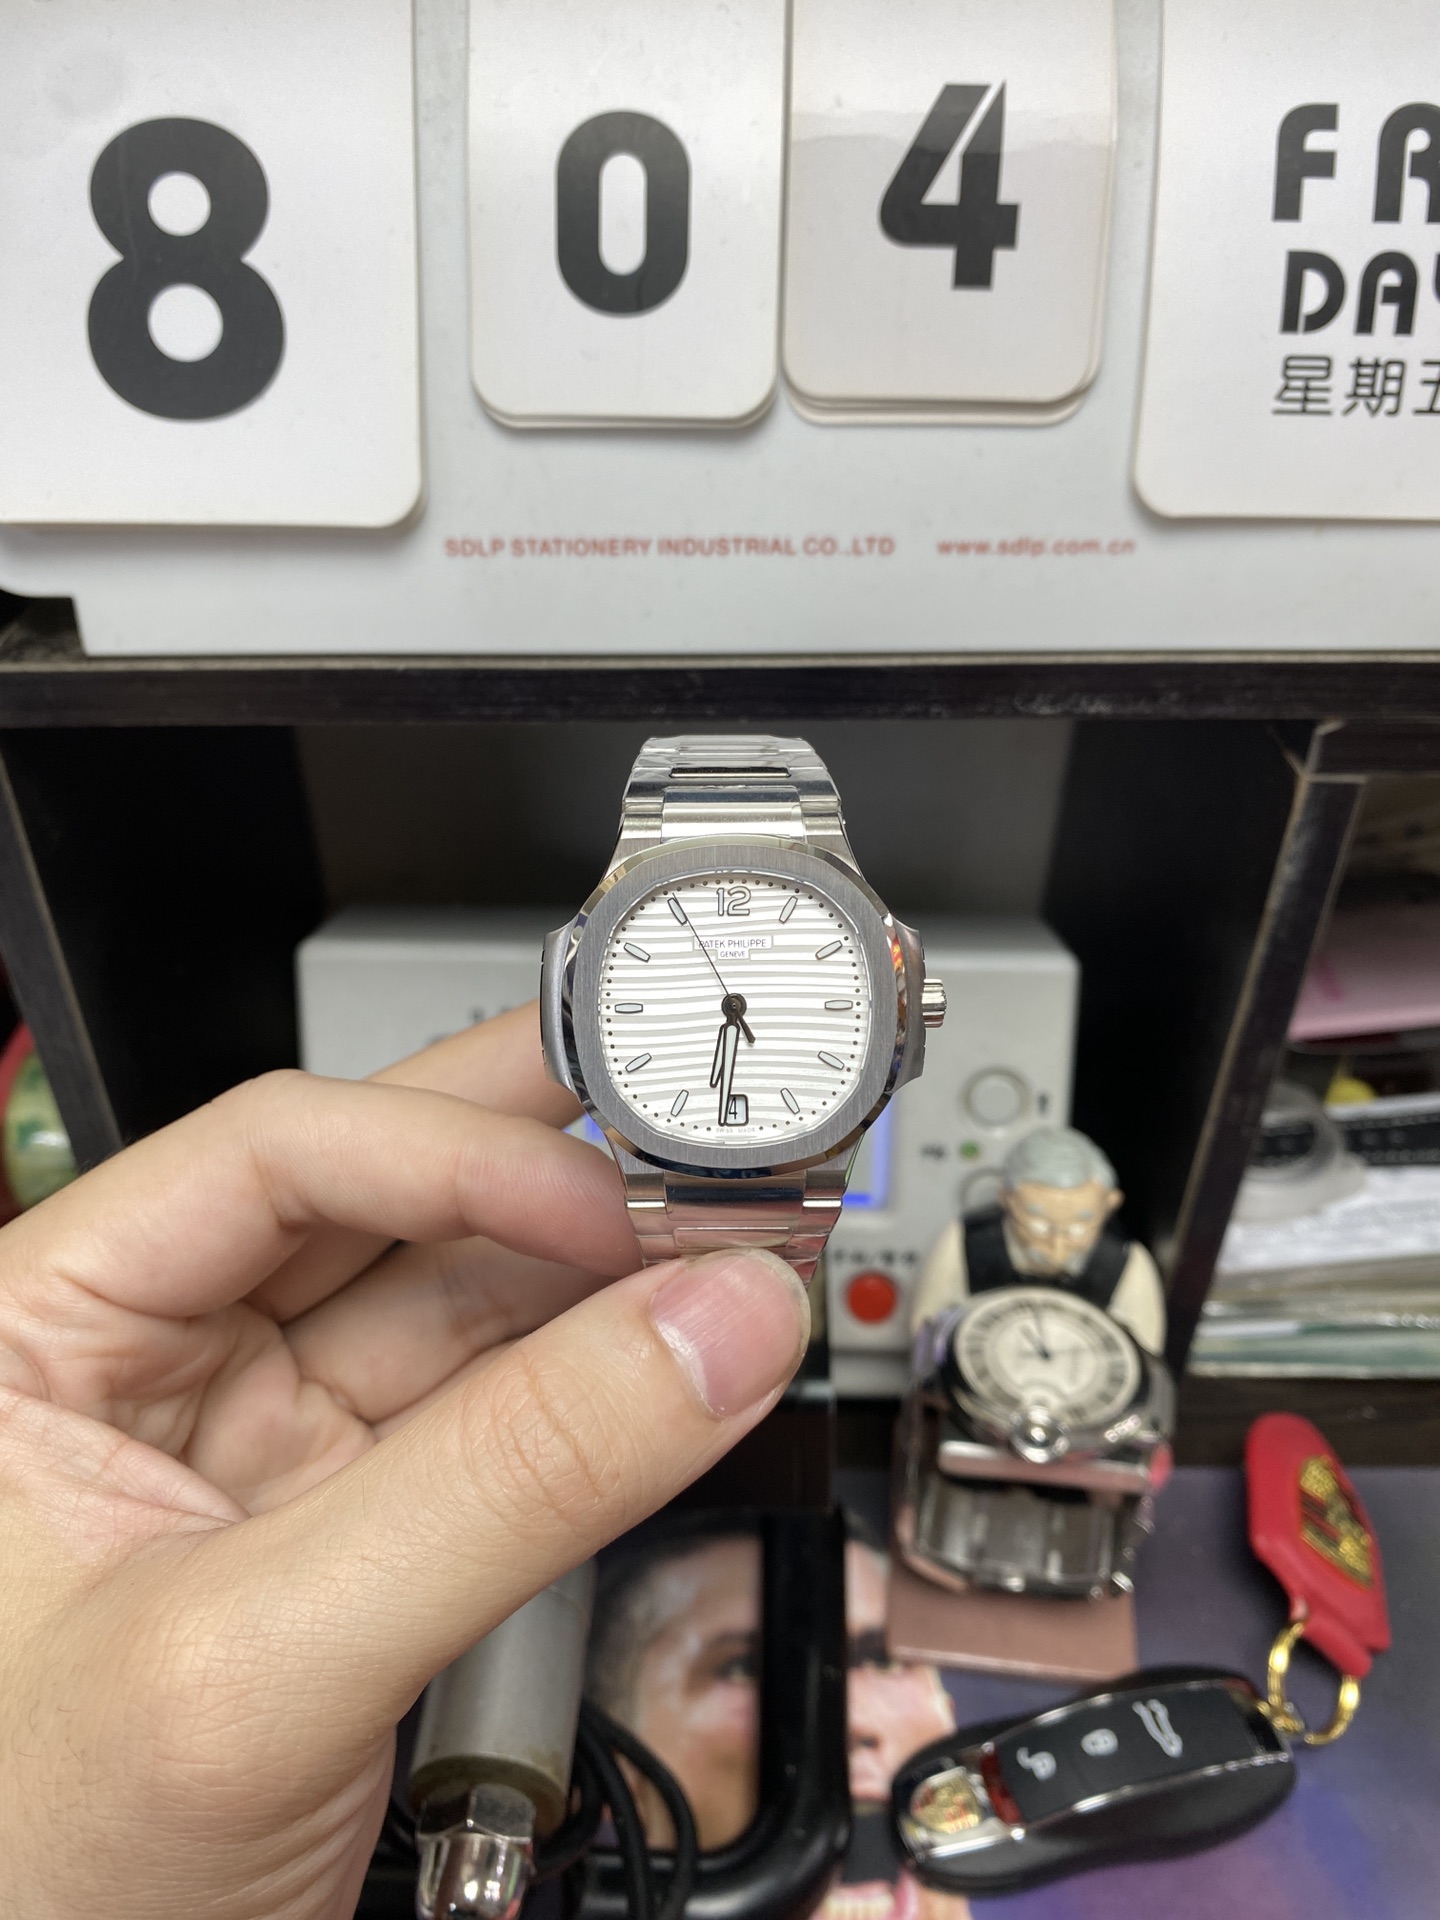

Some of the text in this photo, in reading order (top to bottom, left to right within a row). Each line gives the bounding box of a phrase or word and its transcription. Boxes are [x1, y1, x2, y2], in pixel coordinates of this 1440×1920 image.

[87, 116, 286, 422] 8
[878, 82, 1019, 290] 4
[1279, 250, 1440, 336] DA
[445, 536, 505, 557] SDLP
[511, 536, 652, 557] STATIONERY
[657, 536, 797, 557] INDUSTRIAL
[716, 886, 752, 916] 12
[728, 938, 767, 948] PHILIPPE
[728, 1096, 738, 1120] 4
